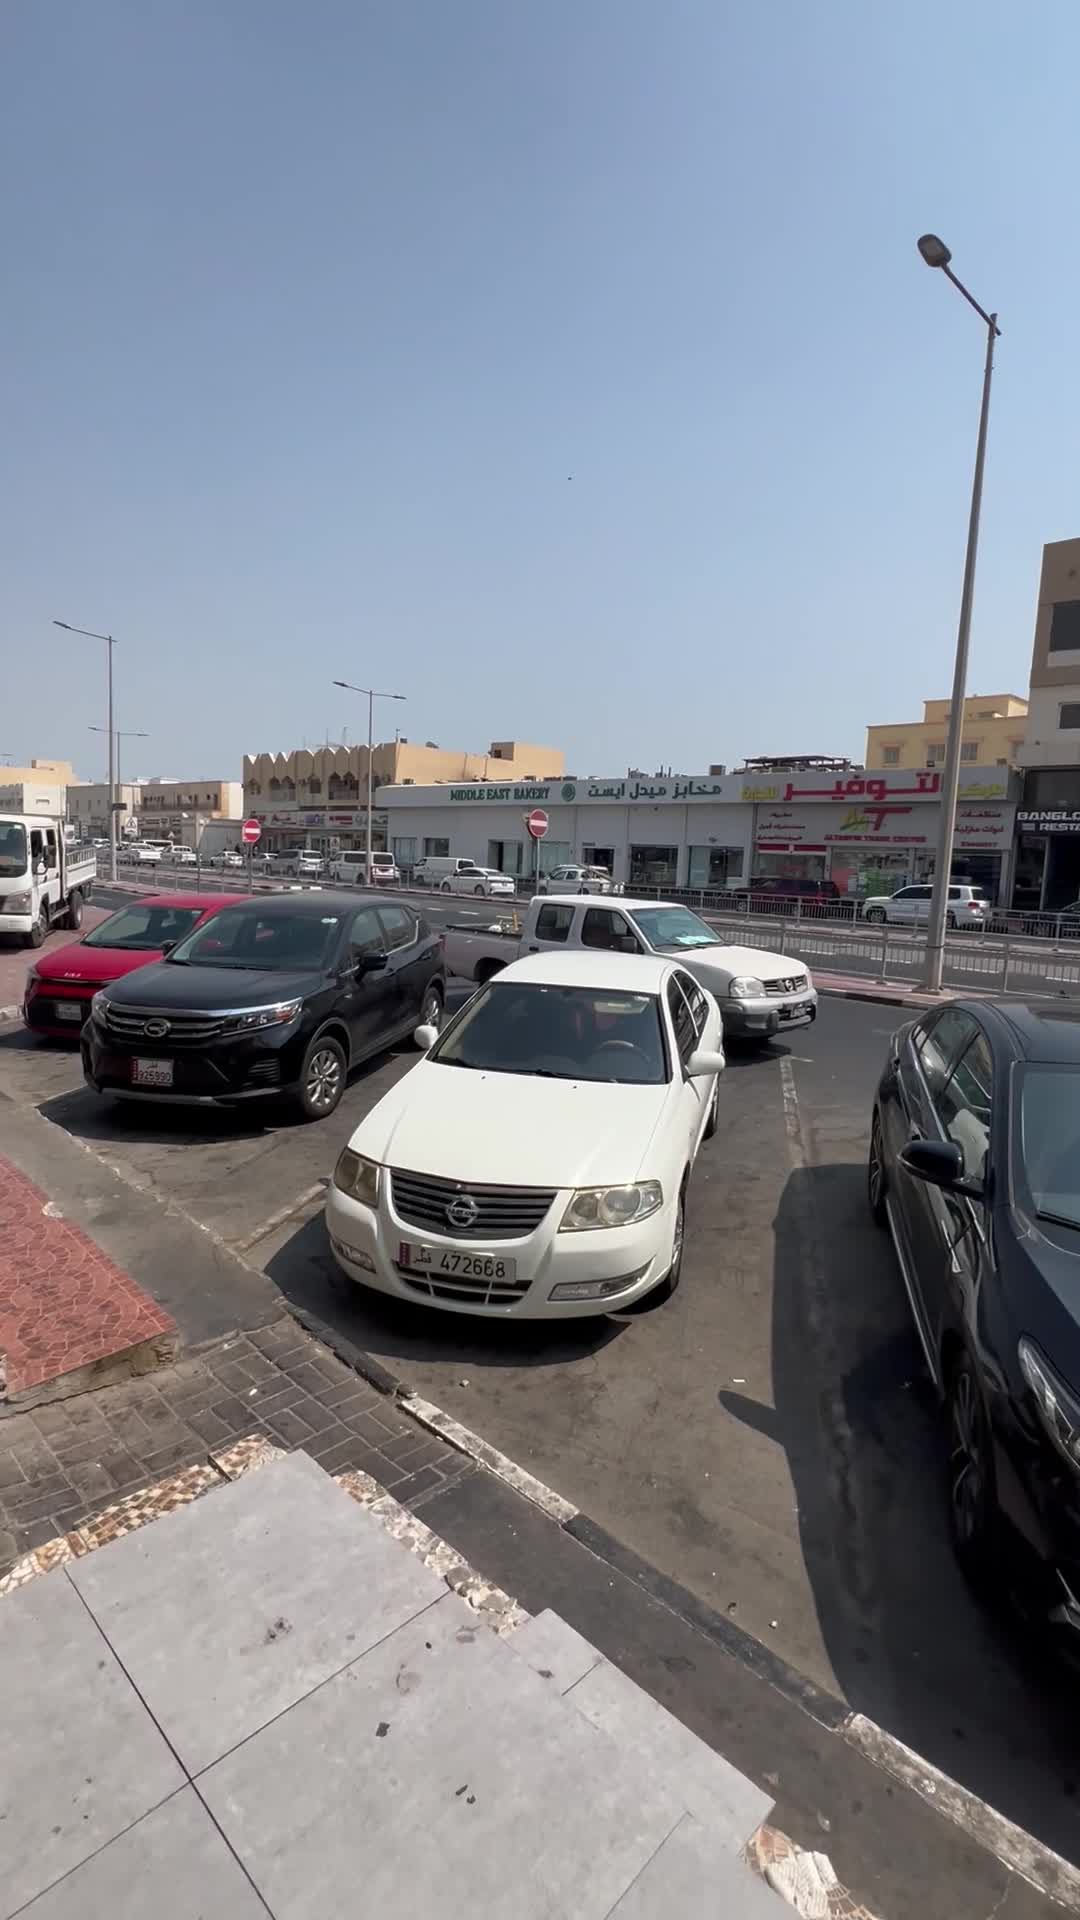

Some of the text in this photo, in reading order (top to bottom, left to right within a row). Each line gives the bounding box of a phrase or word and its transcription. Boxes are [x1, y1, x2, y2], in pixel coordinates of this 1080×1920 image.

[450, 786, 551, 801] MIDDLE EAST BAKERY
[629, 782, 667, 799] ميدل
[672, 781, 722, 799] مخابز
[440, 1253, 506, 1278] 472668
